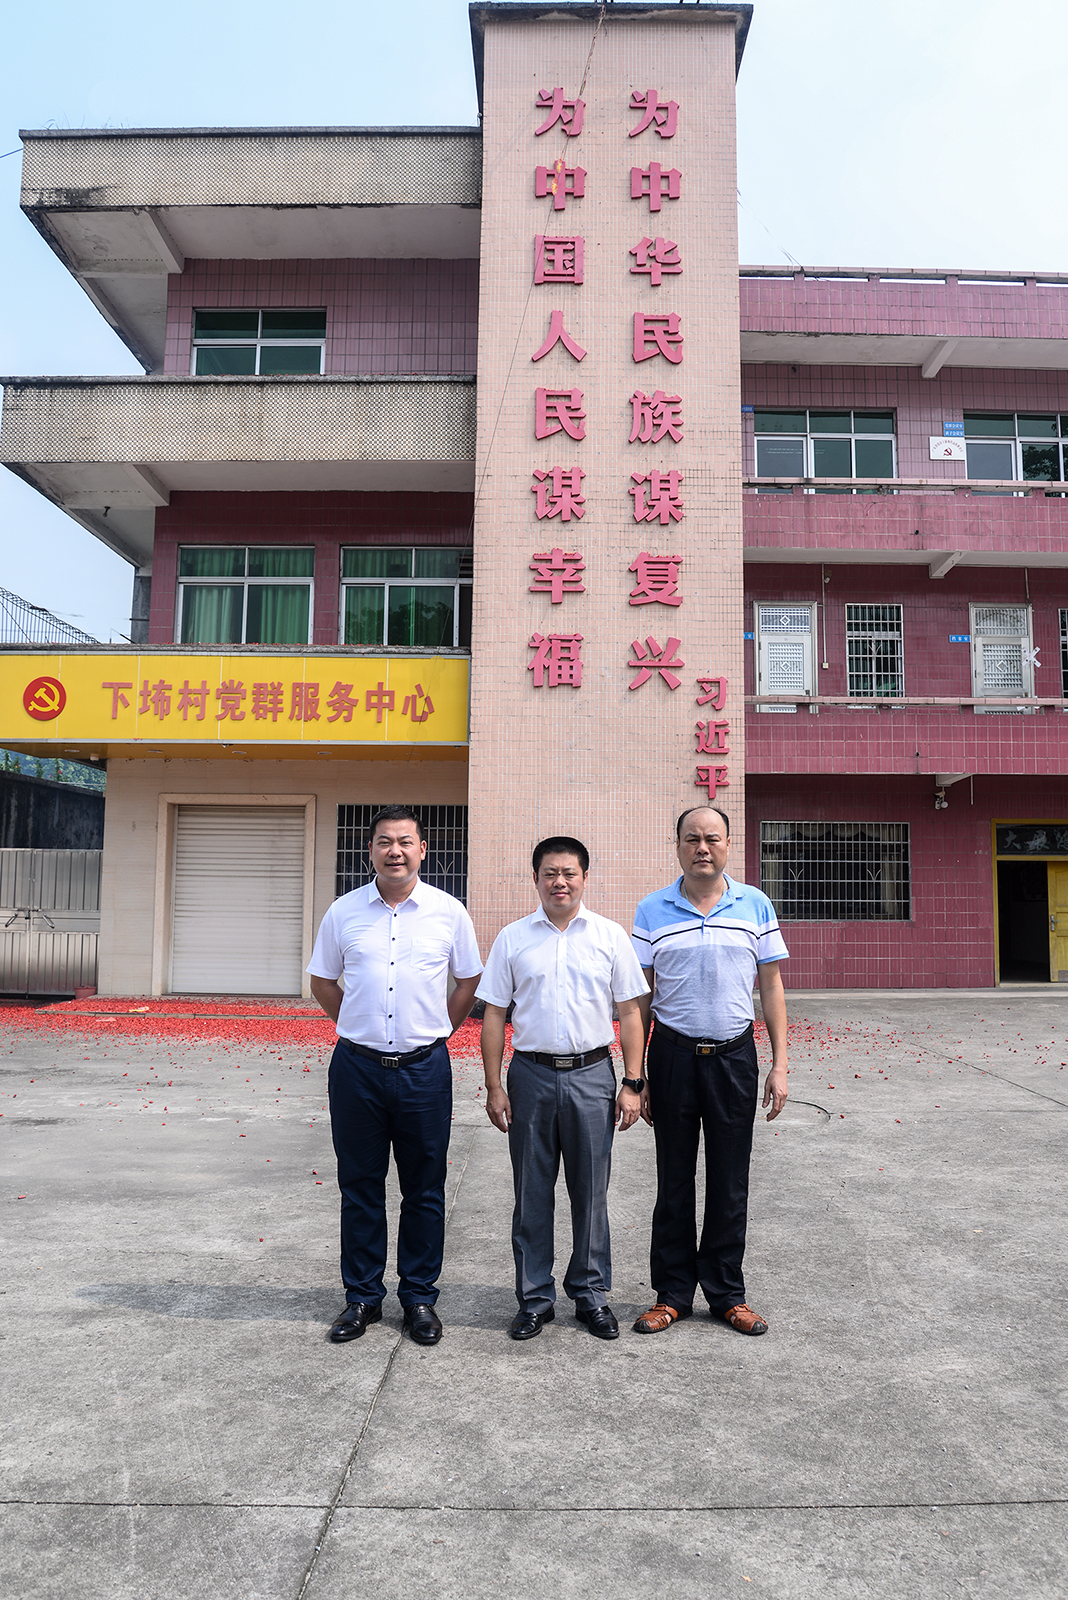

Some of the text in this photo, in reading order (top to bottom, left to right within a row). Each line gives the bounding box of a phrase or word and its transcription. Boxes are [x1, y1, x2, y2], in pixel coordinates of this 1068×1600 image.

[528, 87, 586, 690] 为中国人民谋幸福
[628, 88, 684, 692] 为中华民族谋复兴
[695, 676, 731, 800] 习近平
